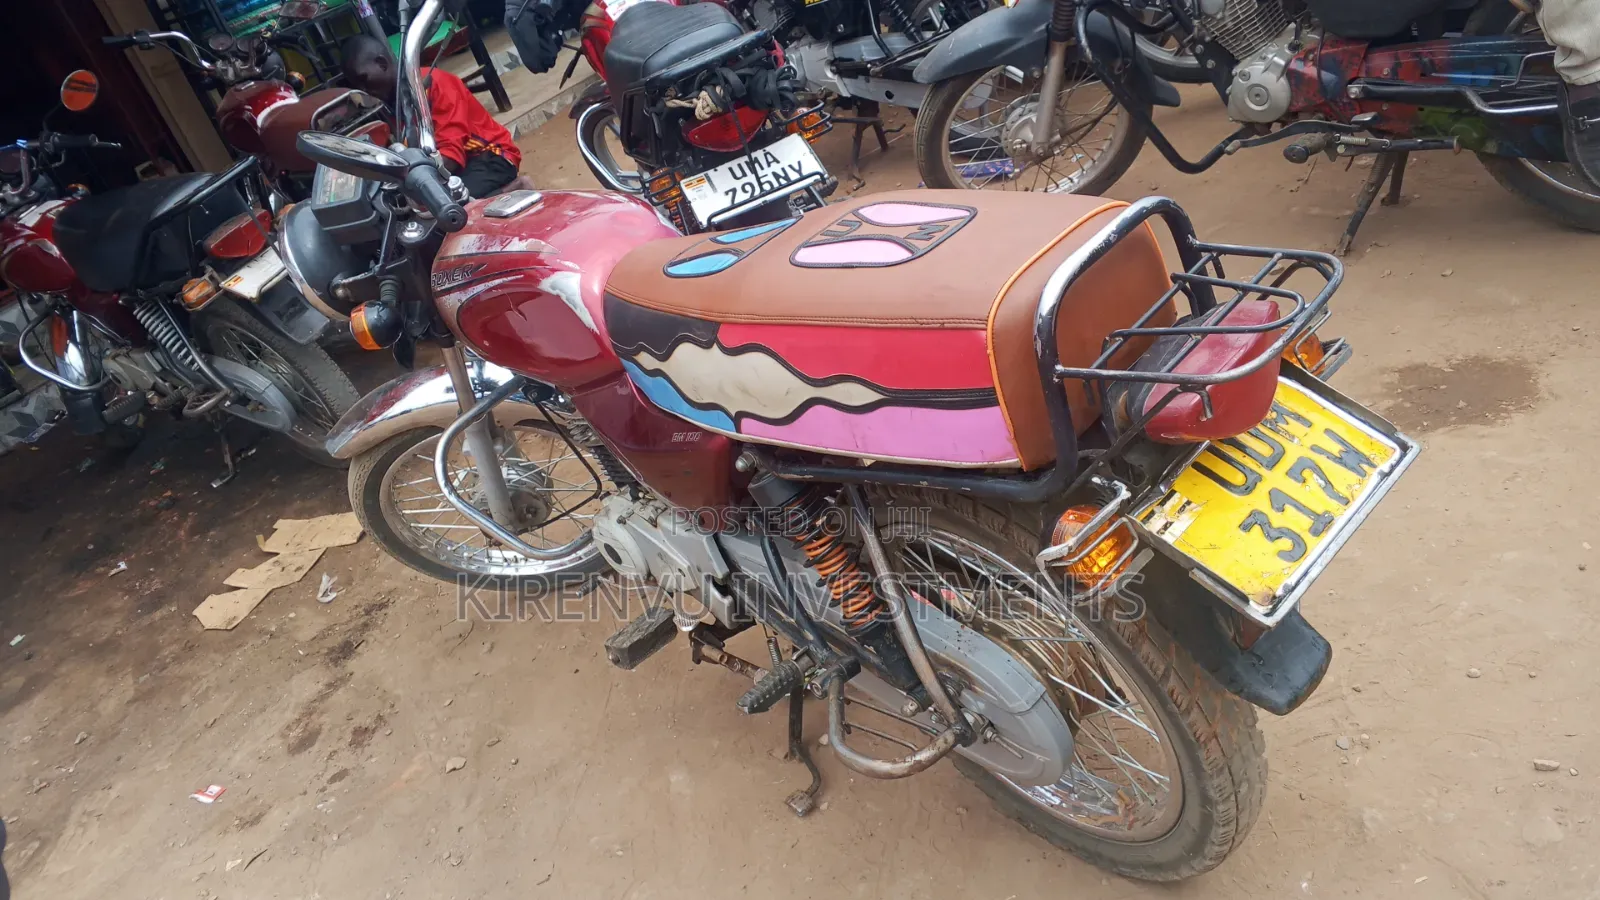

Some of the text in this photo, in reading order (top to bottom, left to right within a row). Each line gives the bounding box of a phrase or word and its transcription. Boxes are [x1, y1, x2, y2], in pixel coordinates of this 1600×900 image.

[728, 150, 781, 181] UMA
[431, 263, 474, 288] BOXER
[1239, 428, 1378, 562] 317W
